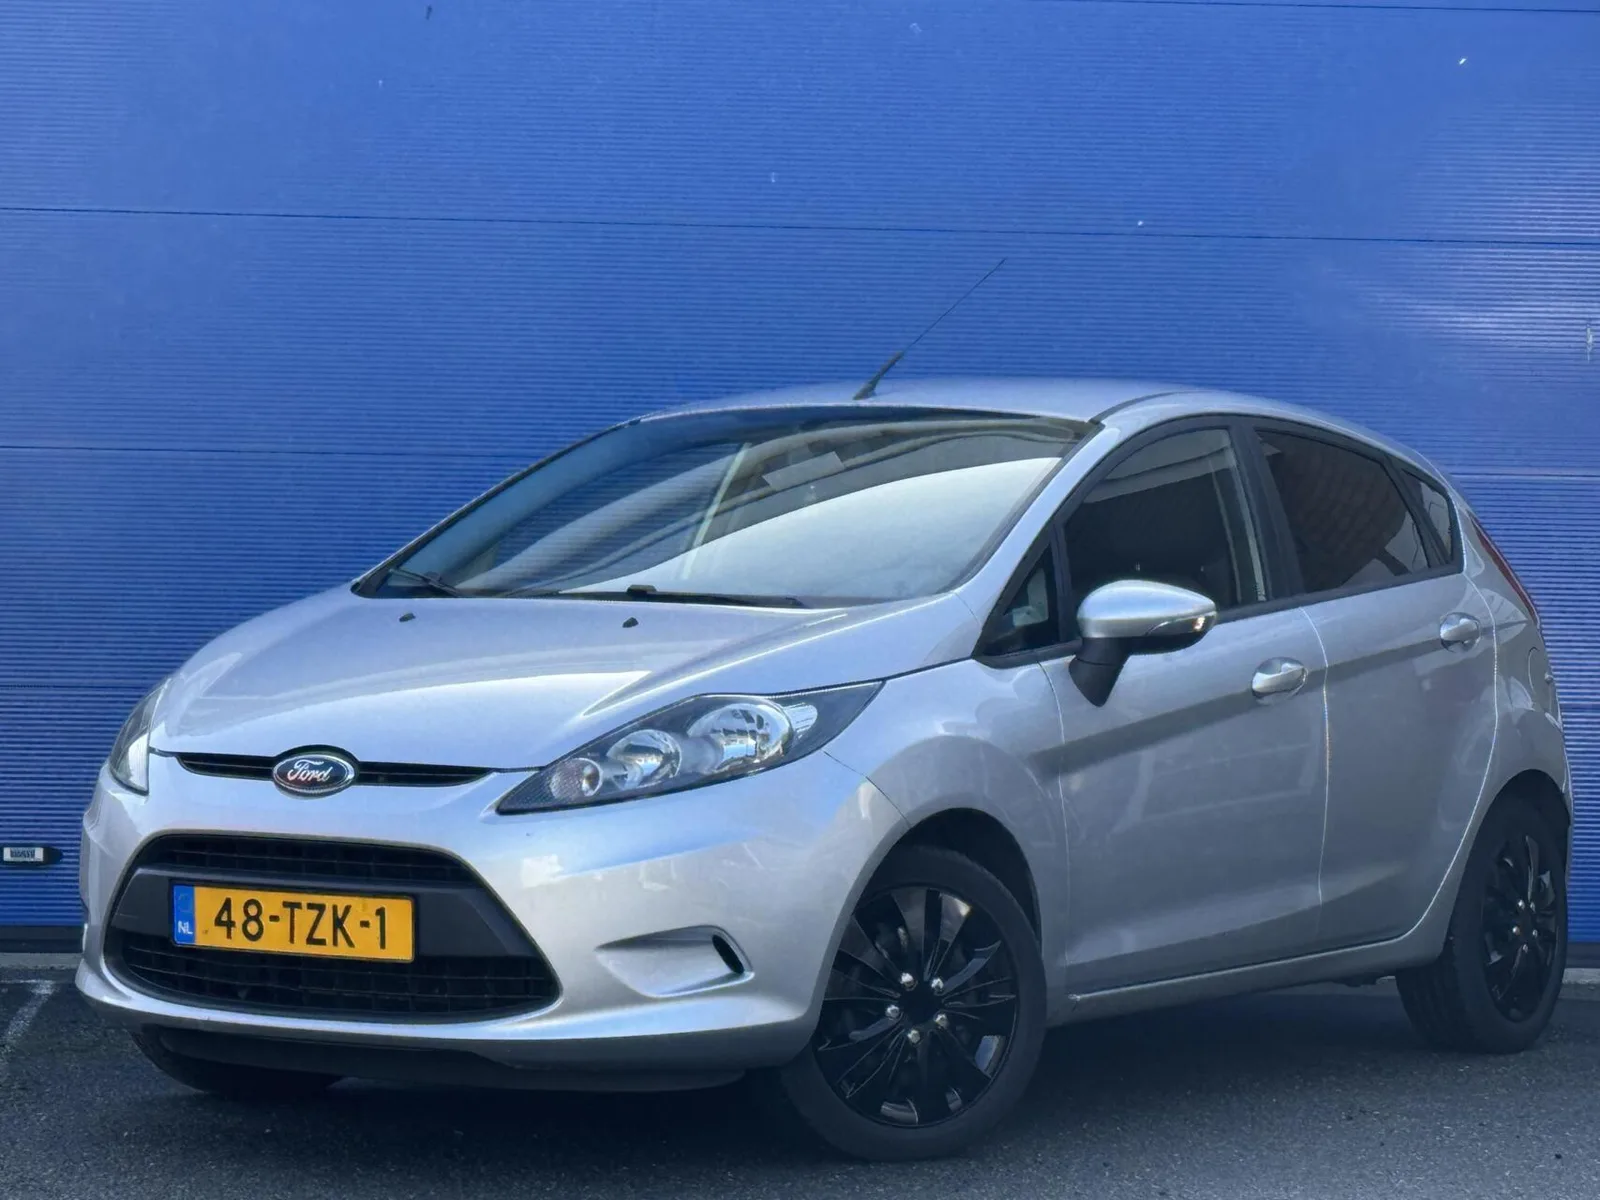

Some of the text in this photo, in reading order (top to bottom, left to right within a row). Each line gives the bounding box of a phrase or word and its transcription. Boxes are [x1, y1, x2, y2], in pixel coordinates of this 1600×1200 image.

[287, 760, 333, 782] Ford
[178, 921, 193, 935] NL
[214, 897, 386, 949] 48-TZK-1
